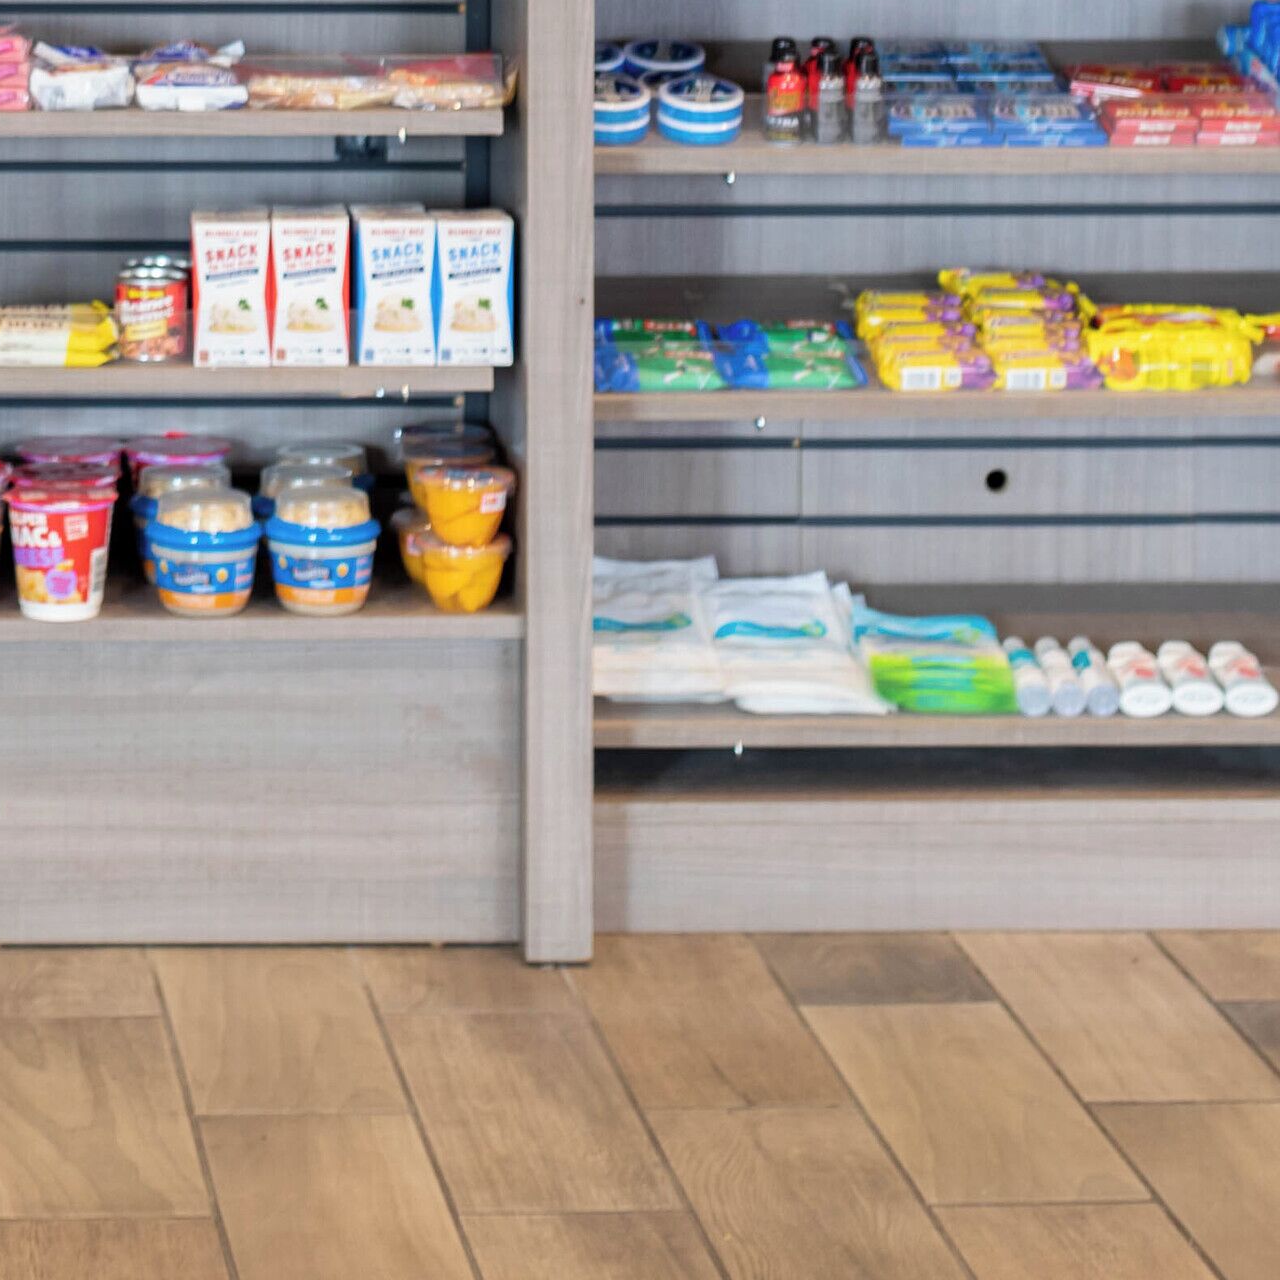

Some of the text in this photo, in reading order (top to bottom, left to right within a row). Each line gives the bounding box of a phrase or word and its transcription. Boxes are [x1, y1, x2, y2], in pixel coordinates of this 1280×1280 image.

[205, 243, 258, 263] SNACK
[283, 243, 337, 262] SNACK
[371, 241, 425, 261] SNACK
[448, 242, 502, 262] SNACK
